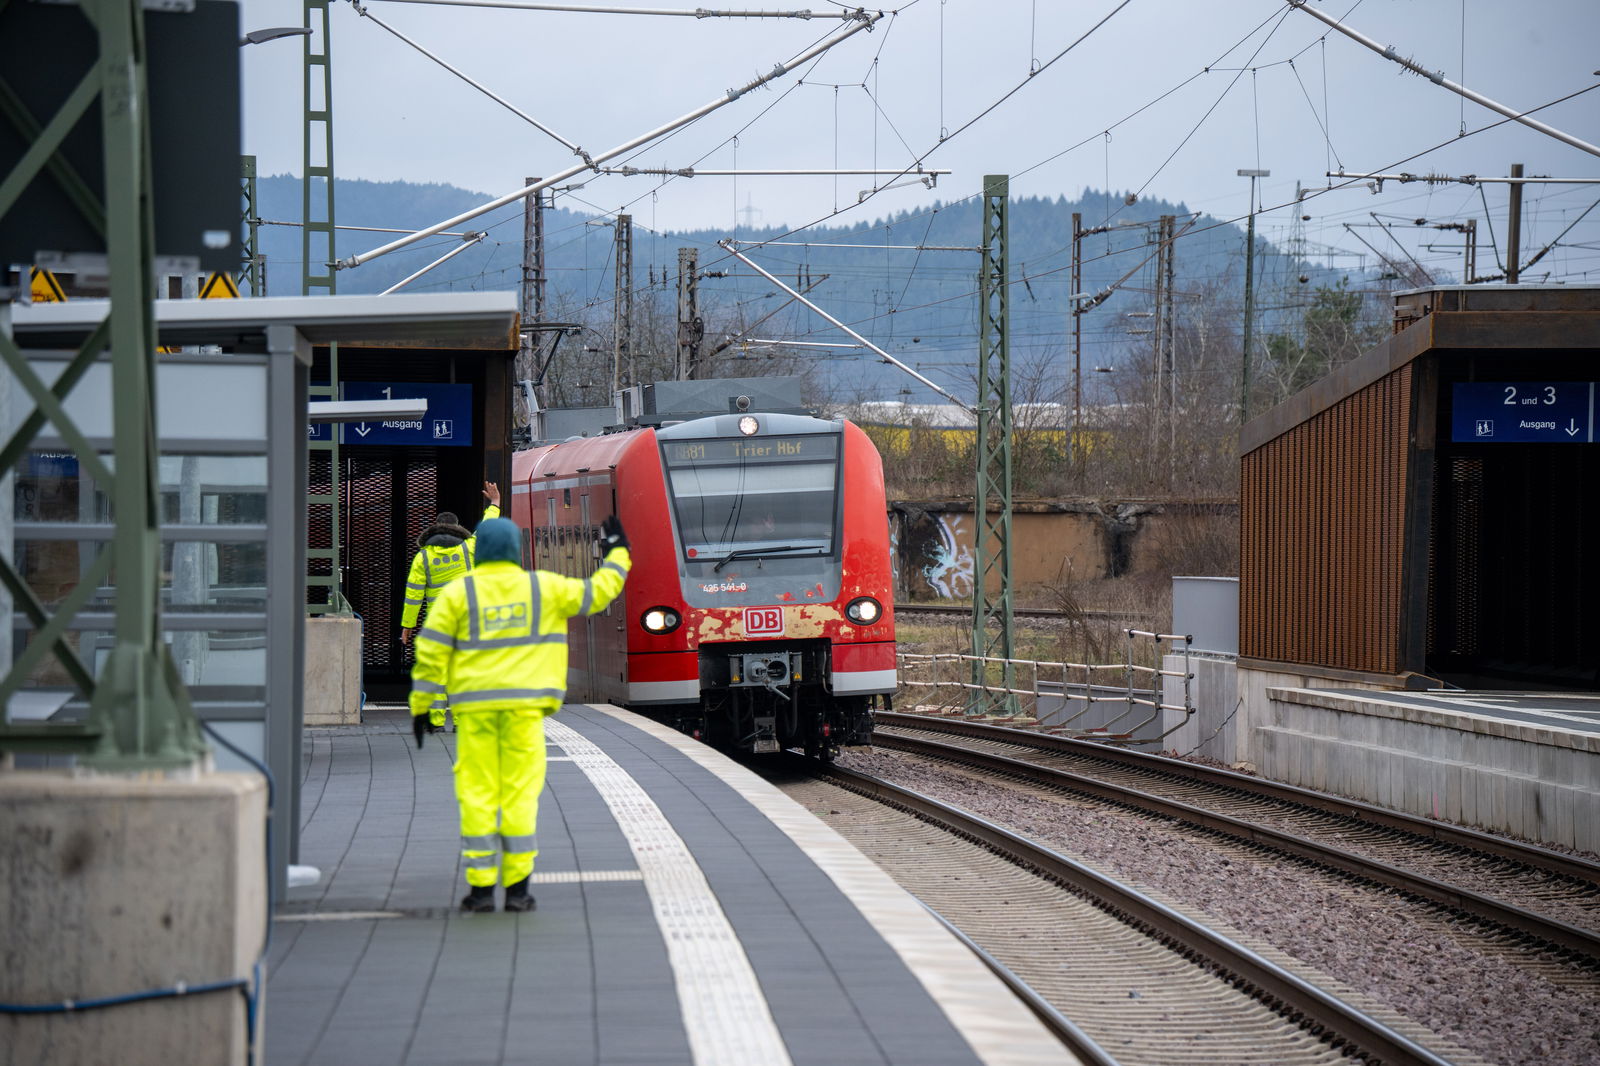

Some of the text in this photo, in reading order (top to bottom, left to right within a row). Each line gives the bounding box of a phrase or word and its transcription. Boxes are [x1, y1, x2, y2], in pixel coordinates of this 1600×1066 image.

[382, 387, 391, 400] 1
[1503, 386, 1557, 405] 2 und 3
[382, 421, 422, 430] Ausgang
[1519, 420, 1556, 430] Ausgang
[732, 442, 772, 457] Trier
[777, 441, 802, 456] Hbf
[750, 611, 778, 629] DB
